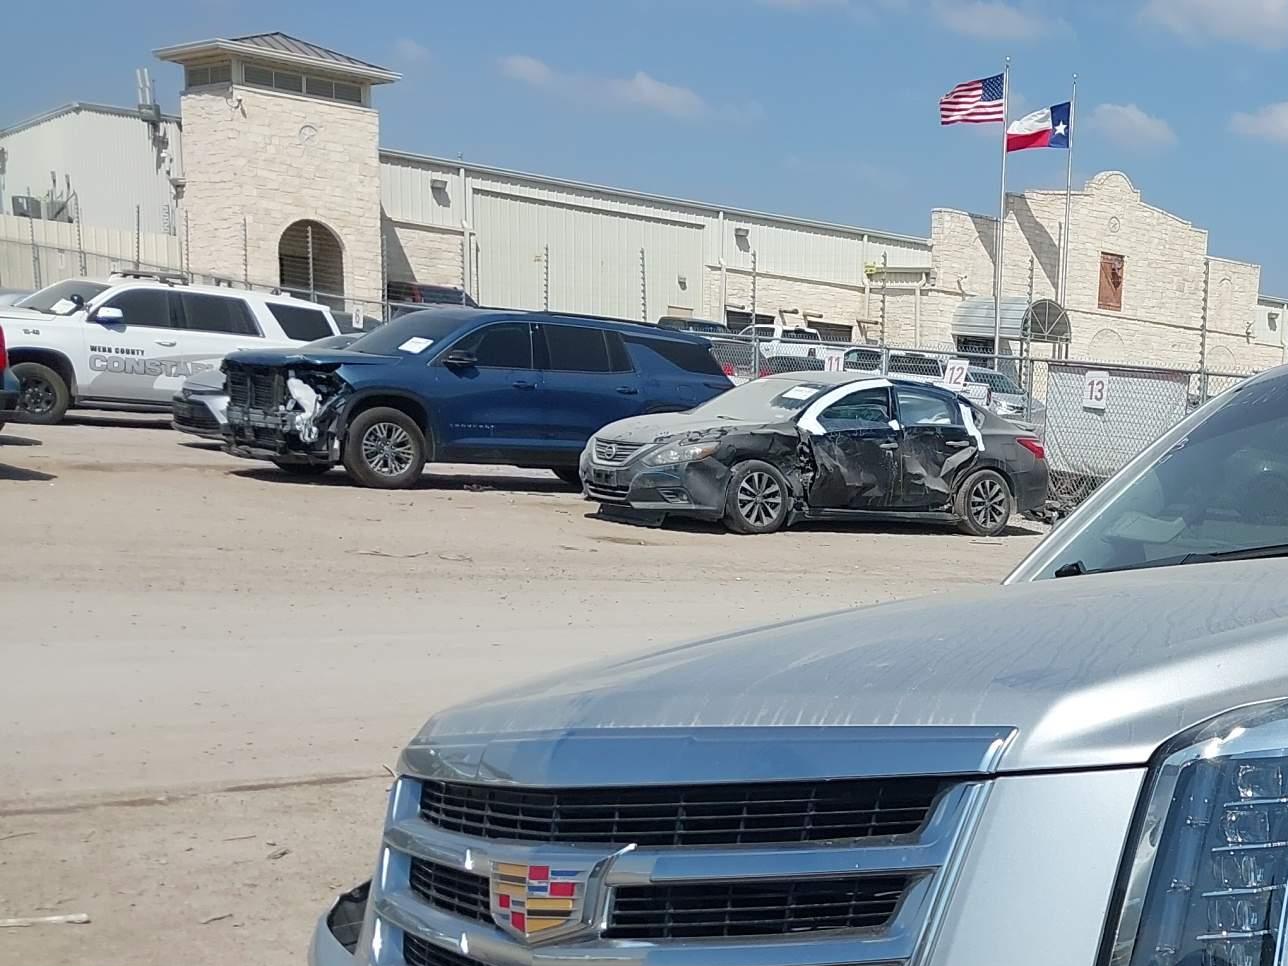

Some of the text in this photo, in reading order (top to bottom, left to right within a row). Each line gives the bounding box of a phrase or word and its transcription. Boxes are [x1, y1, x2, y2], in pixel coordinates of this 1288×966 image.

[114, 347, 145, 356] COUNTY
[827, 356, 841, 372] 11
[949, 366, 965, 385] 12
[1088, 380, 1105, 402] 13
